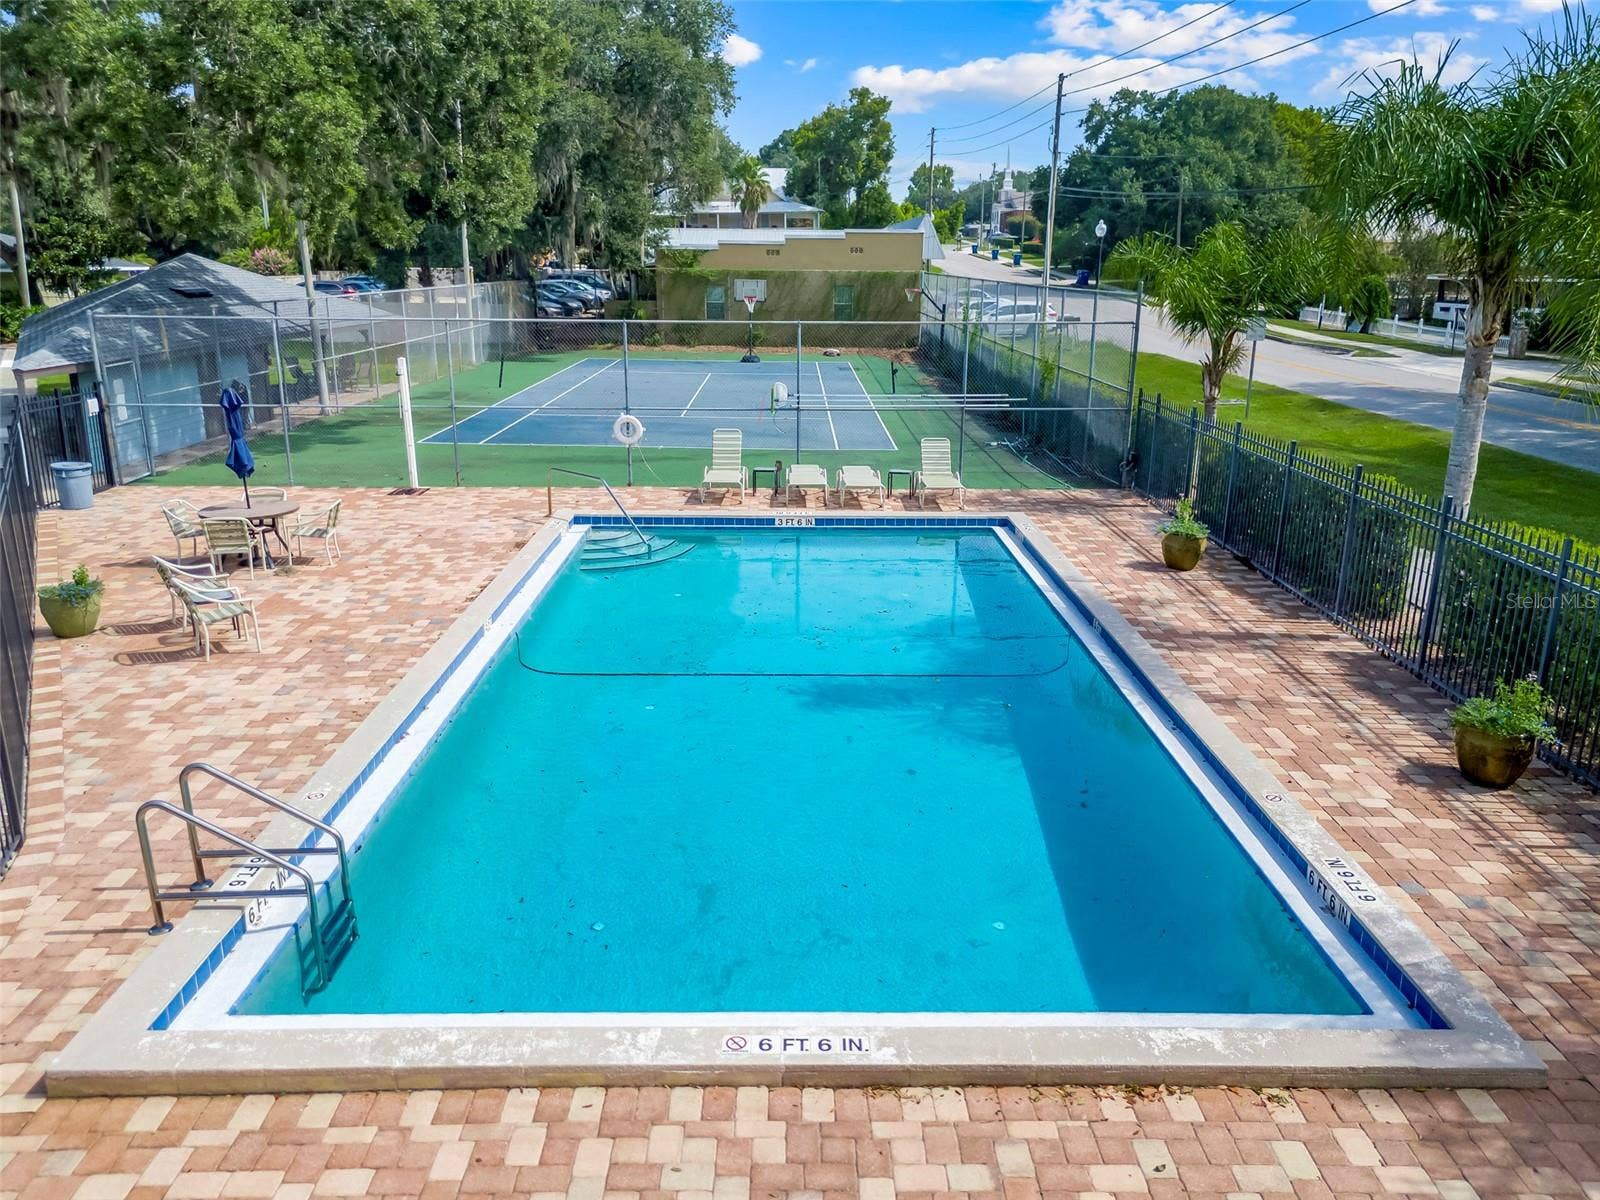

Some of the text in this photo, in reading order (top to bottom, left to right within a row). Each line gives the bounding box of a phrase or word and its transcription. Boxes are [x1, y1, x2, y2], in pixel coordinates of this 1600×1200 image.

[777, 518, 783, 526] 3
[797, 518, 803, 526] 6
[1325, 857, 1347, 869] IN.
[1308, 870, 1315, 886] 6
[1329, 895, 1337, 910] 6
[248, 907, 255, 924] 6
[758, 1038, 869, 1052] 6 FT. 6 IN.
